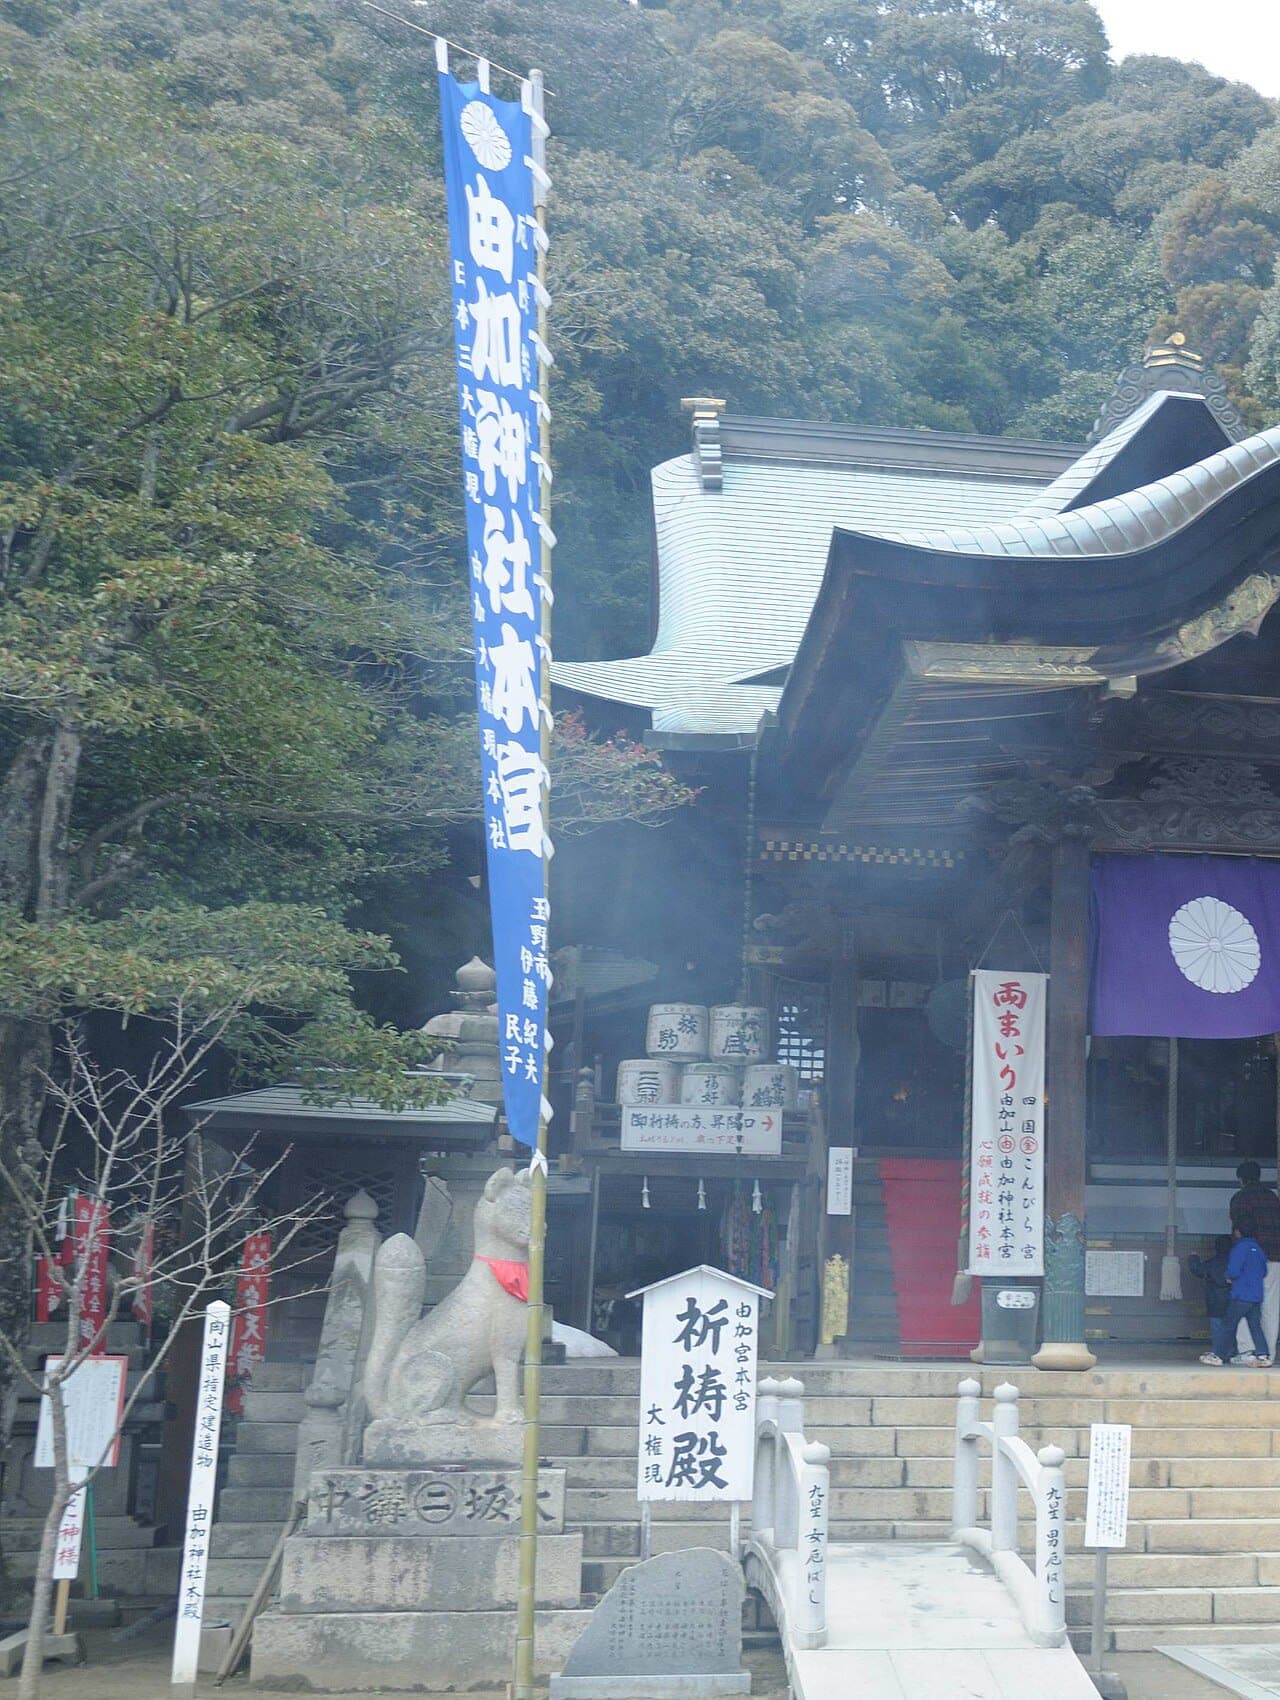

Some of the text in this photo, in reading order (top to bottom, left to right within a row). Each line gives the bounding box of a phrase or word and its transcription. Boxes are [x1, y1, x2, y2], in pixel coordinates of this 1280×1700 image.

[993, 981, 1028, 1092] 両まいり
[733, 1301, 753, 1412] 由加宮本宮
[644, 1403, 666, 1484] 大権現
